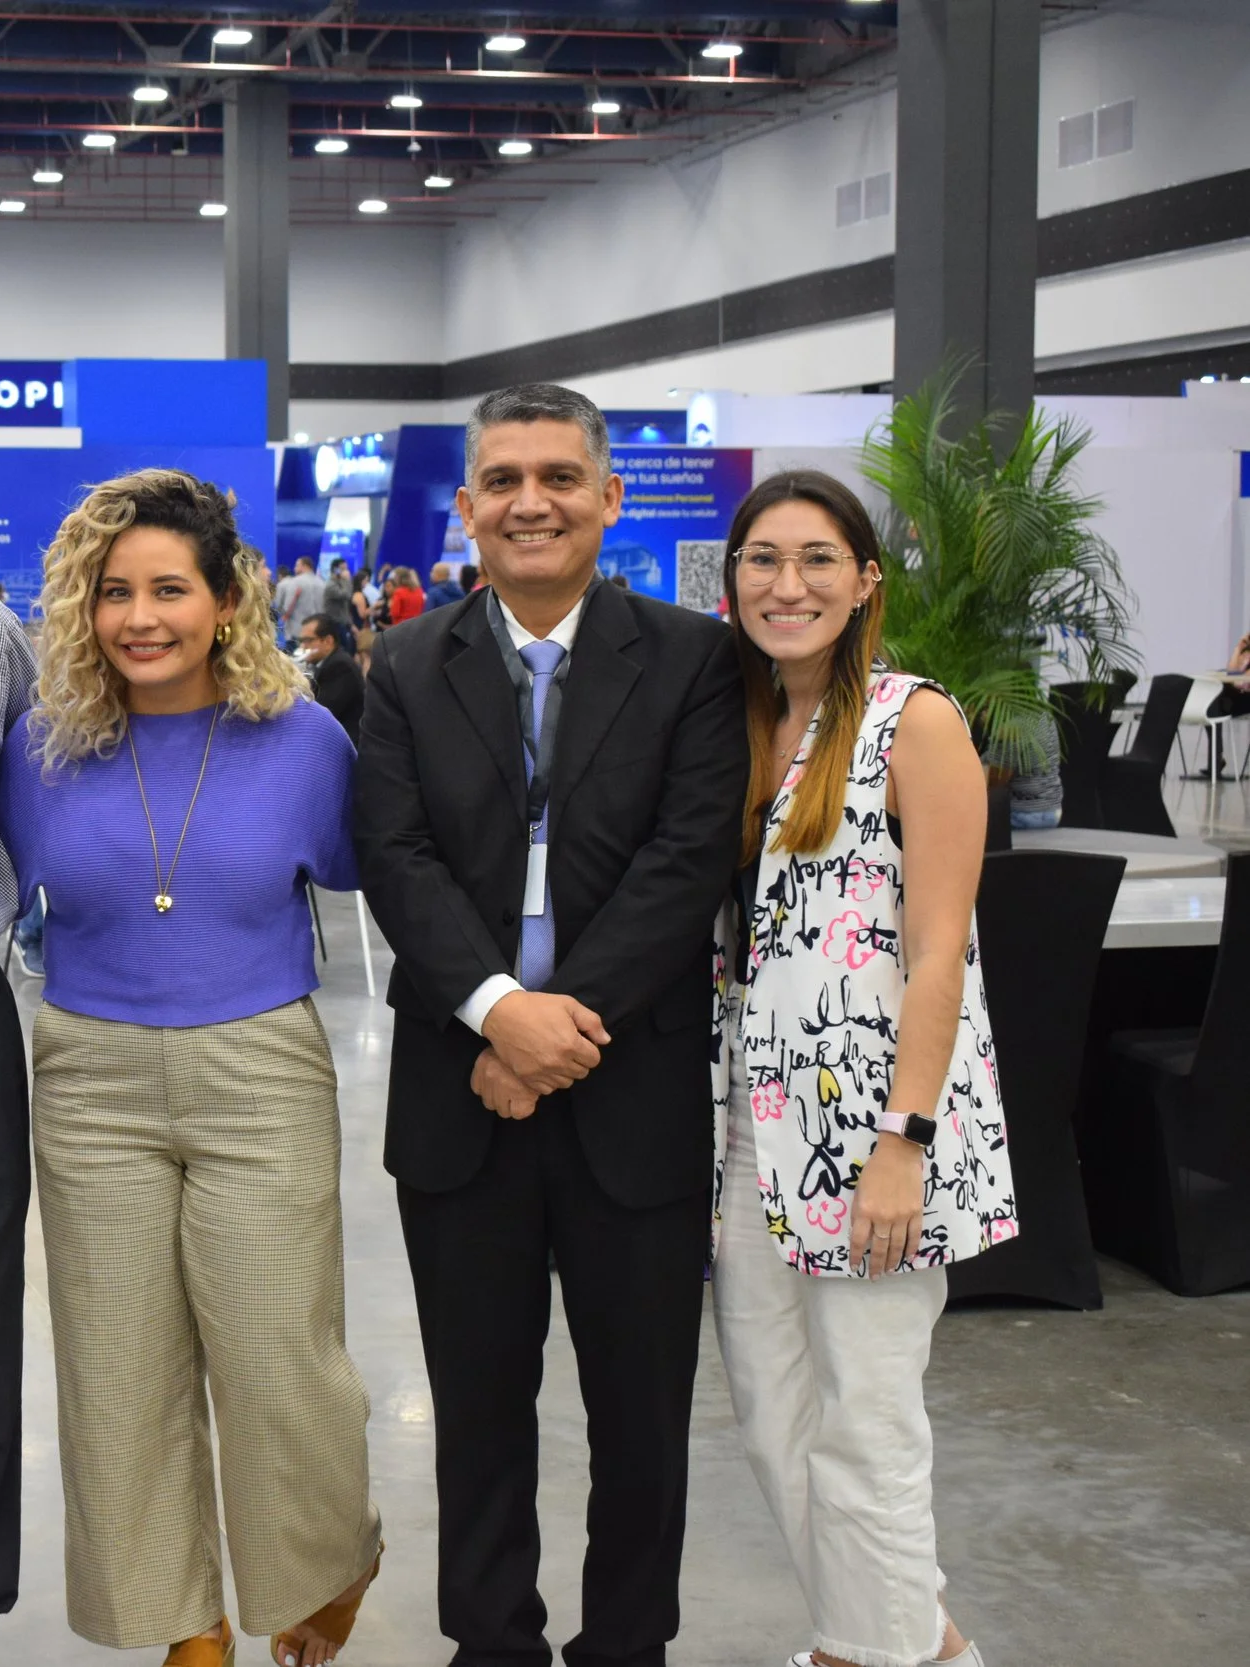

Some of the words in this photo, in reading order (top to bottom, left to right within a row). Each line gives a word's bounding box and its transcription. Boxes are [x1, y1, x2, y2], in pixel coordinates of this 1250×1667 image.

[627, 458, 663, 470] cerca
[664, 456, 682, 470] de
[639, 473, 659, 485] tus
